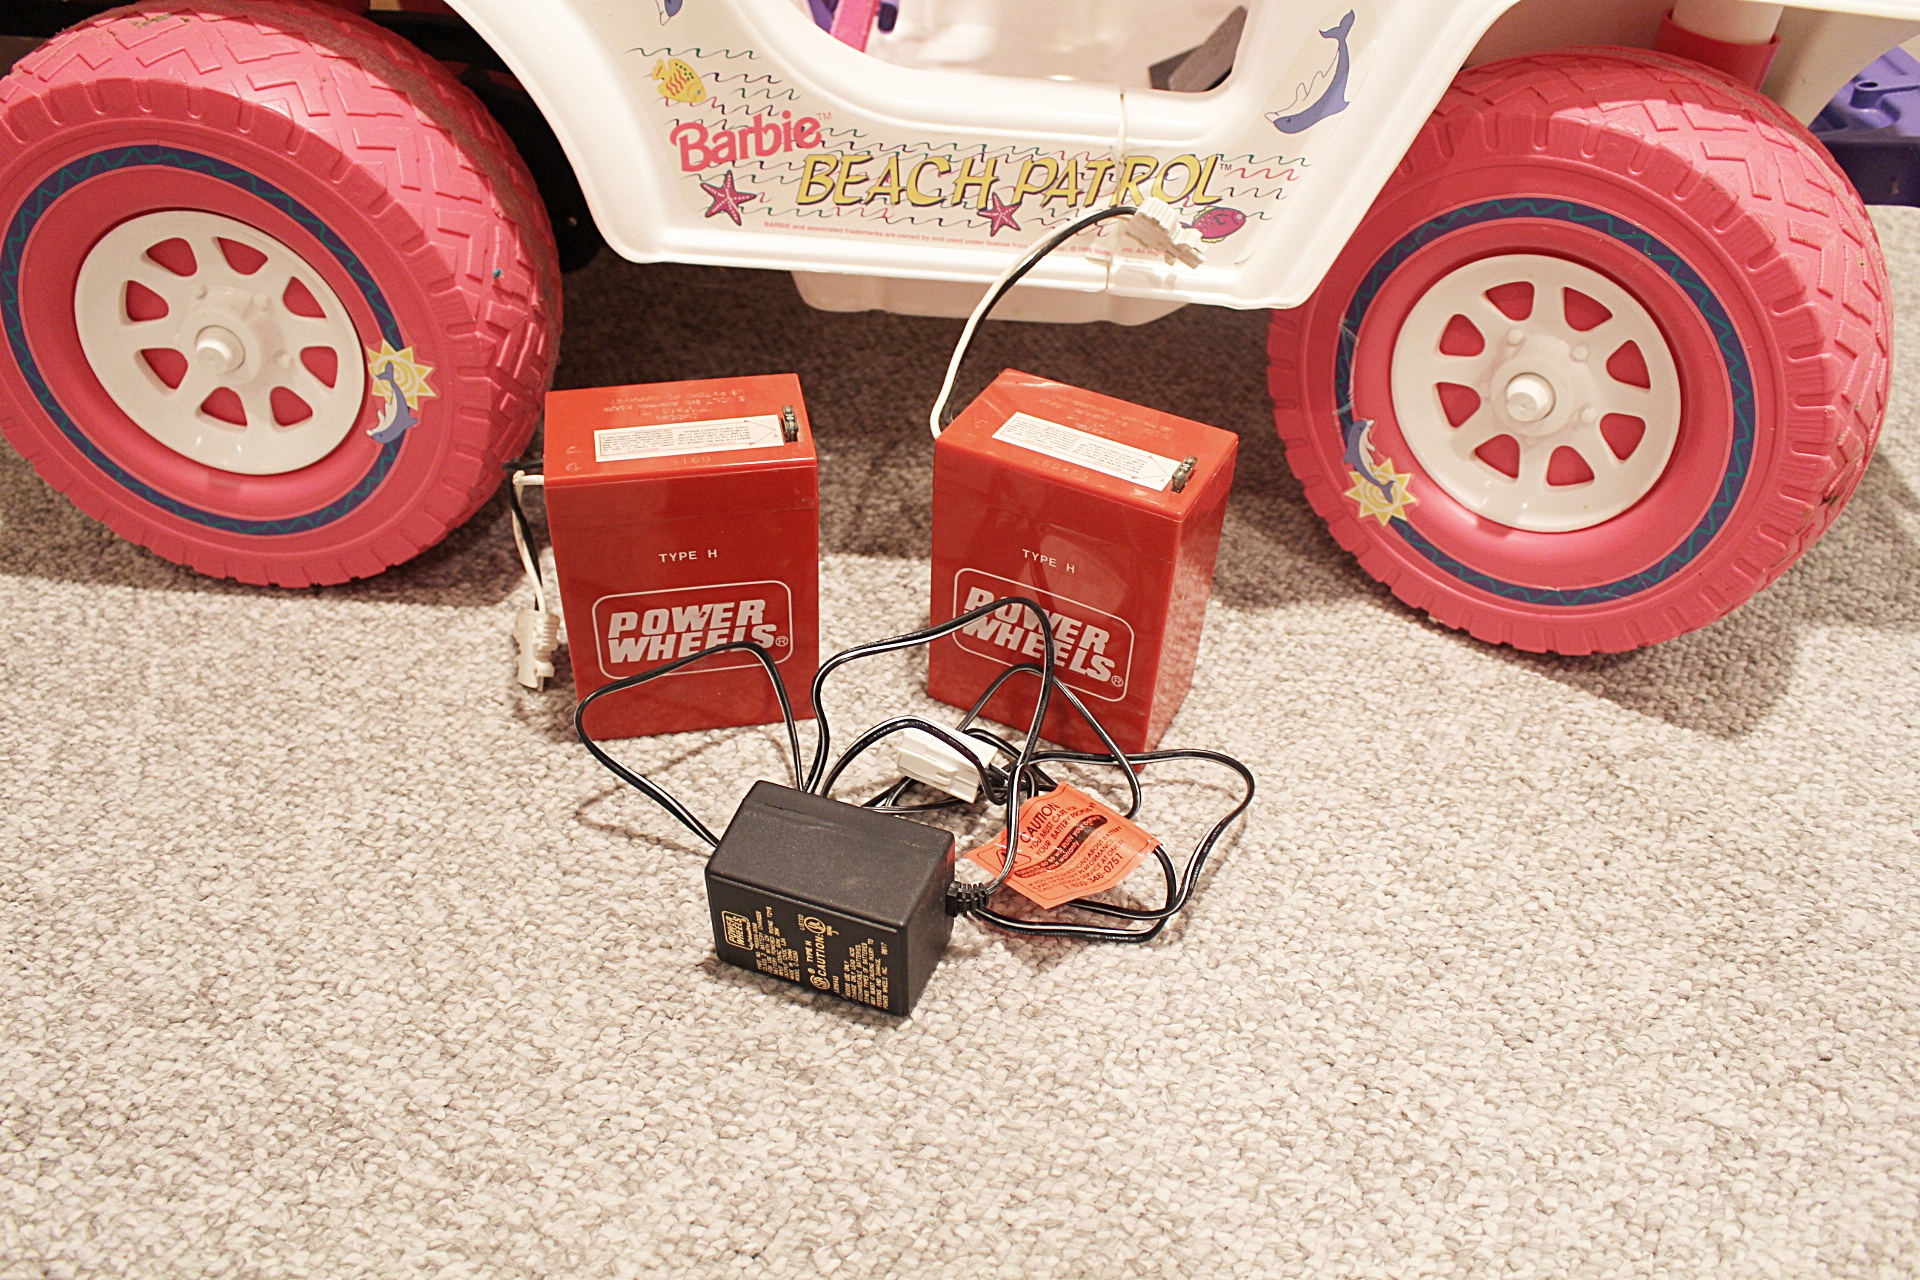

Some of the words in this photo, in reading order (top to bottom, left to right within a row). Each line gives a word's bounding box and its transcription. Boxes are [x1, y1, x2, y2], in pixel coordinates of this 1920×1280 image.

[670, 110, 822, 172] Barbie
[796, 154, 1000, 209] BEACH
[1011, 154, 1223, 207] PATROL
[764, 221, 790, 229] BARBIE
[845, 228, 883, 237] trademarks
[921, 233, 930, 242] by
[986, 239, 1011, 248] license
[658, 550, 698, 563] TYPE
[707, 549, 718, 559] H
[1022, 548, 1057, 568] TYPE
[1066, 563, 1075, 574] H
[608, 599, 766, 639] POWER
[964, 586, 1110, 656] POWER
[608, 624, 777, 664] WHEELS
[962, 611, 1116, 682] WHEELS
[1020, 803, 1060, 843] CAUTION
[1028, 836, 1042, 850] YOU
[1040, 821, 1054, 839] MUST
[1052, 809, 1068, 823] CARE
[1035, 840, 1052, 856] YOUR
[1050, 816, 1070, 840] BATTERY
[1061, 835, 1075, 849] RUIN
[1087, 839, 1104, 858] ABOUT
[1101, 825, 1122, 841] BATTERY
[1101, 855, 1109, 865] AT
[805, 947, 813, 962] TYPE
[815, 933, 826, 977] CAUTION:
